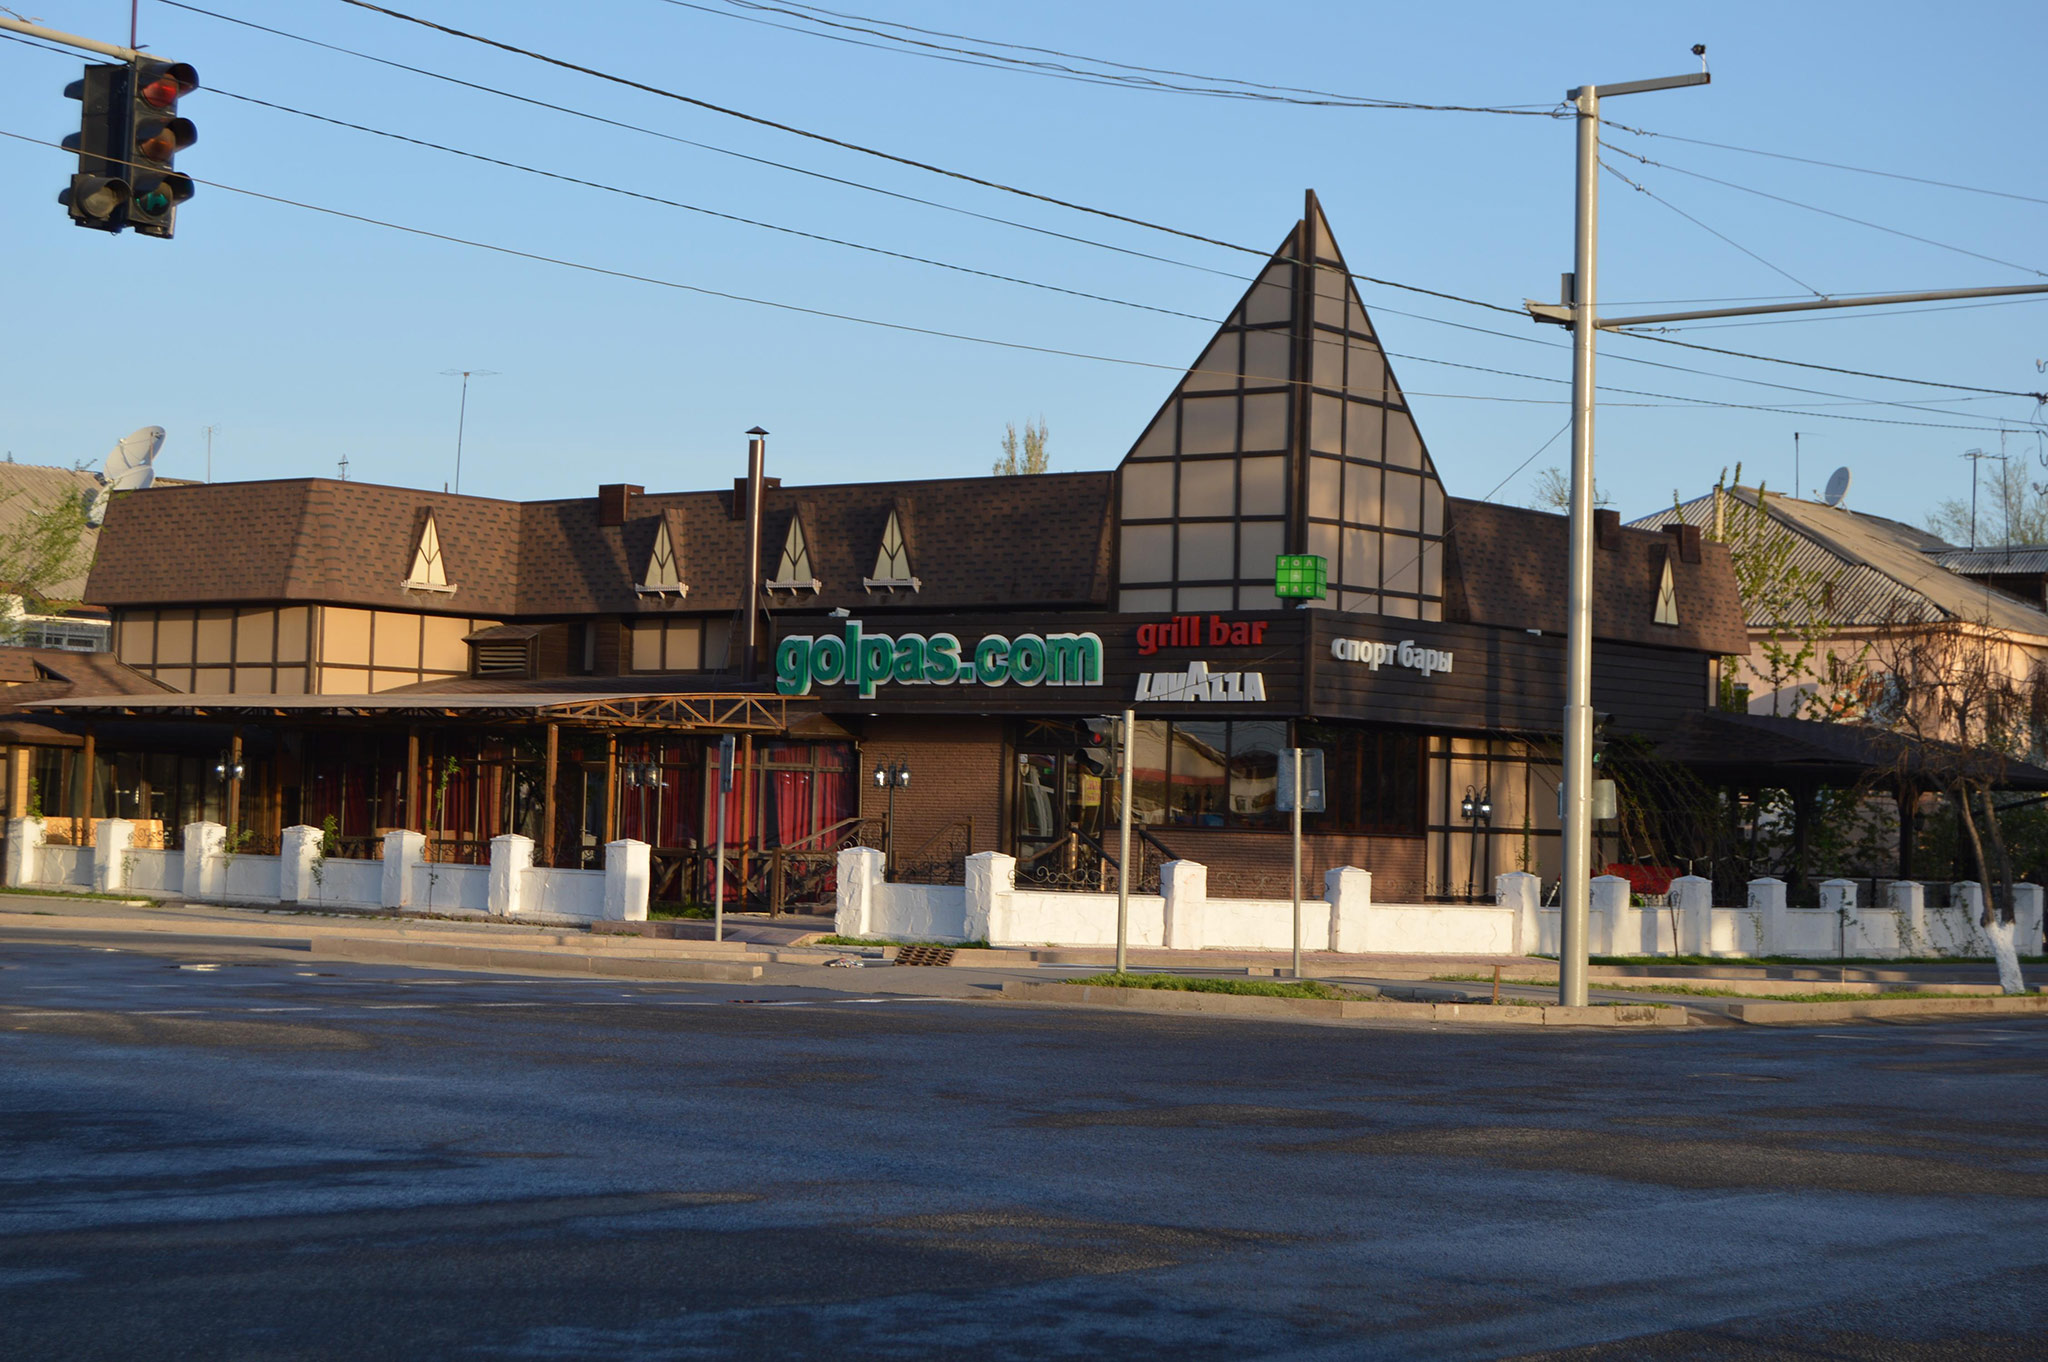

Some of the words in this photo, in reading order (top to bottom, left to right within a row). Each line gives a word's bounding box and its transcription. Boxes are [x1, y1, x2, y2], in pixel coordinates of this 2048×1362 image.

[1279, 585, 1313, 593] ПАС
[1136, 615, 1201, 656] grill
[1209, 614, 1268, 646] bar
[775, 620, 1104, 700] golpas.com
[1331, 638, 1398, 672] спорт
[1398, 640, 1453, 677] бары
[1134, 660, 1267, 702] LAVAZZA
